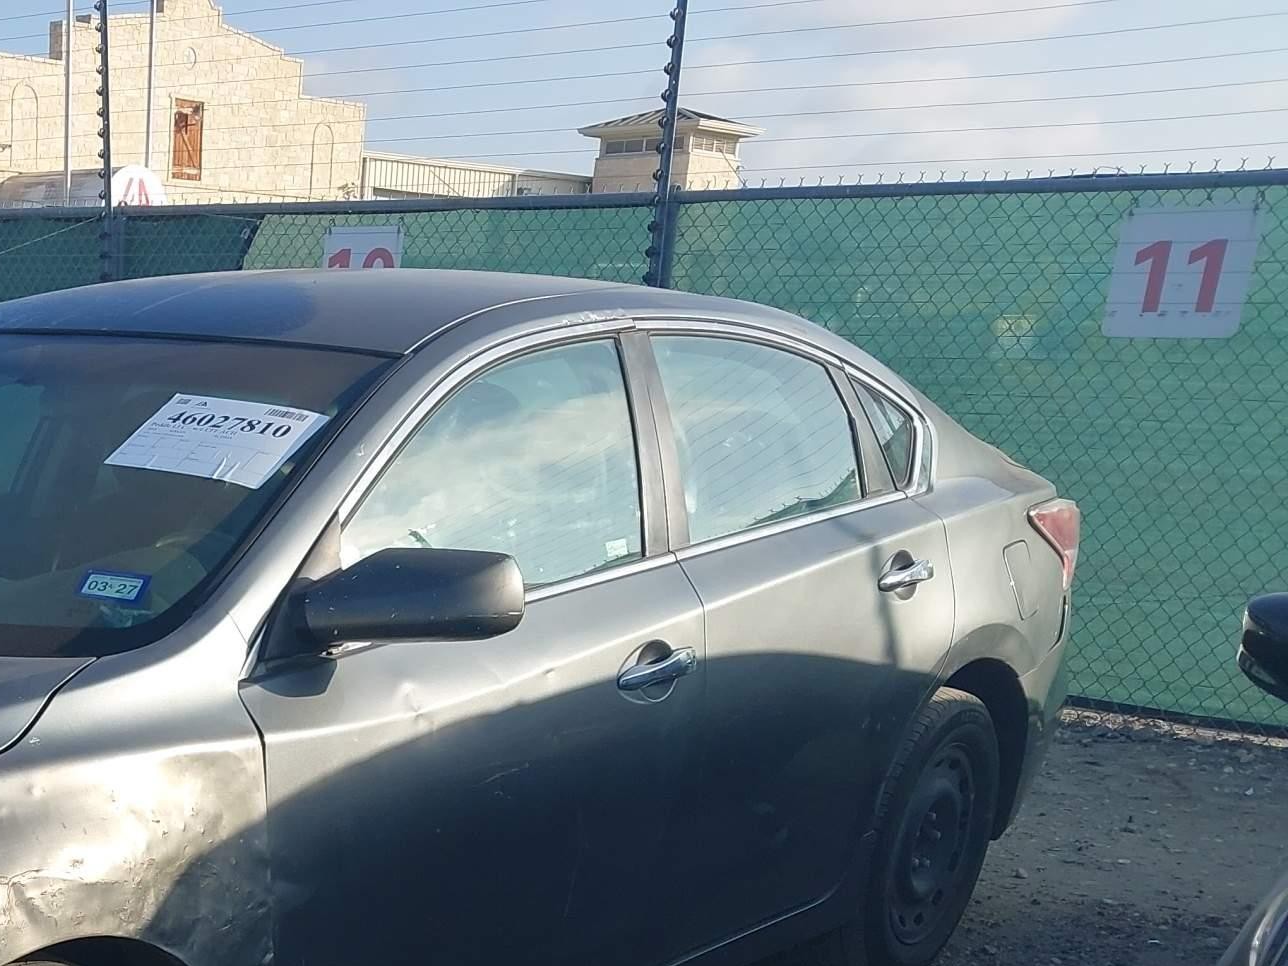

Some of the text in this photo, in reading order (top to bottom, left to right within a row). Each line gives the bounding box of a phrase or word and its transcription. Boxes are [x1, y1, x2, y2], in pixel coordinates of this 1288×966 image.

[1134, 239, 1229, 313] 11
[167, 410, 292, 438] 46027810
[87, 580, 139, 595] 03 27
